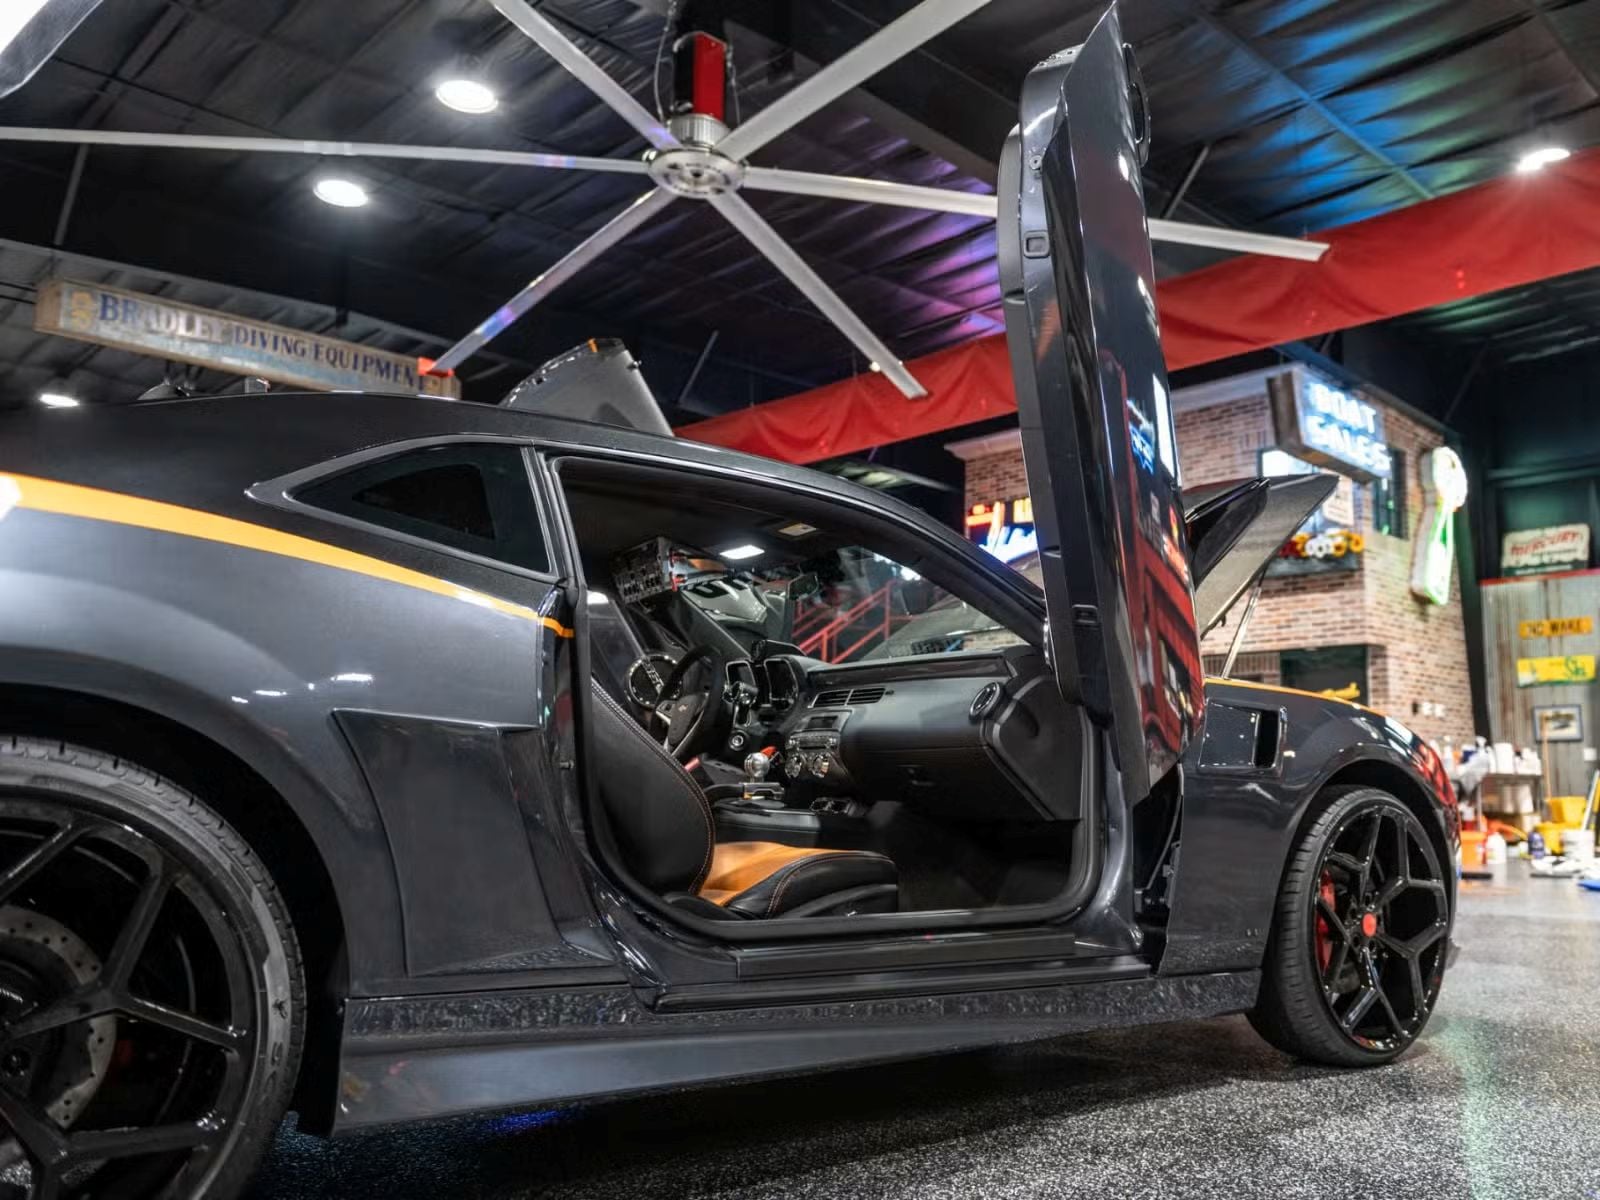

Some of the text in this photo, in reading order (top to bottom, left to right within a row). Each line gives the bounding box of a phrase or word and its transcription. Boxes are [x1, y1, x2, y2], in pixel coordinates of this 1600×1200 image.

[100, 293, 232, 344] BRADLEY
[235, 326, 306, 357] DIVING
[1310, 383, 1376, 433] BOAT
[1306, 415, 1390, 470] SALES
